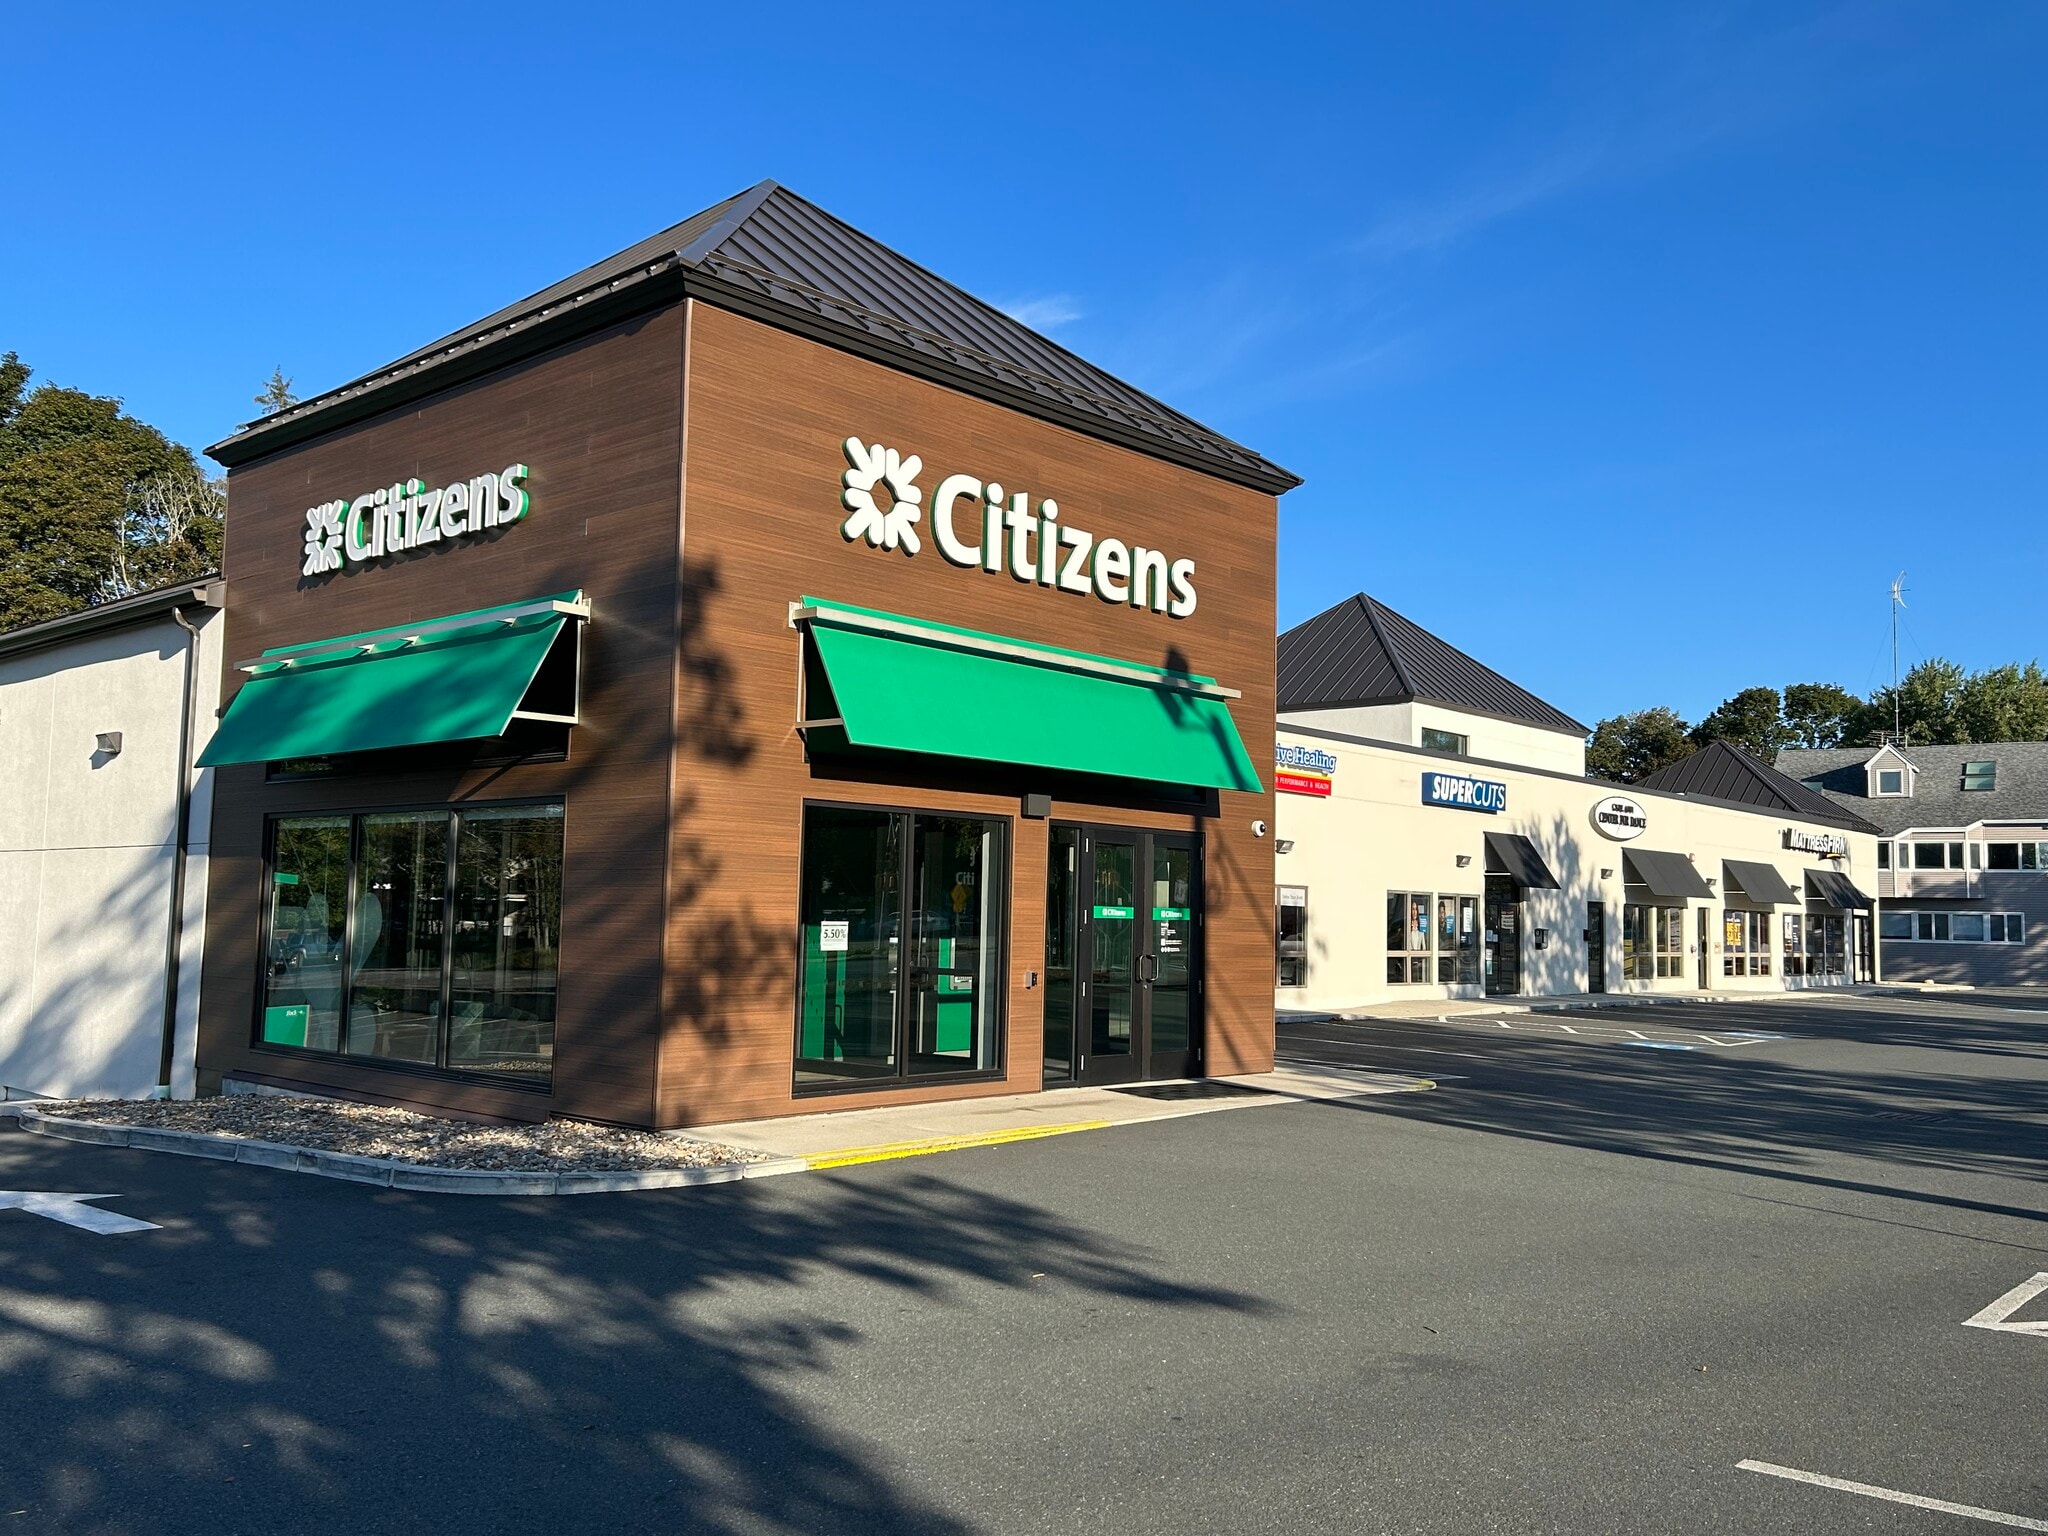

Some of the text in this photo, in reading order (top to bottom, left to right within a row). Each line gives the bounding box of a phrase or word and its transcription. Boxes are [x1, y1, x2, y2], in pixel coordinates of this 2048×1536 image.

[345, 463, 529, 562] Citizens
[930, 473, 1198, 619] Citizens
[1275, 742, 1337, 774] ive Healing
[1432, 775, 1505, 809] SUPERCUTS
[956, 871, 975, 886] Citi
[823, 928, 847, 939] 5.50%
